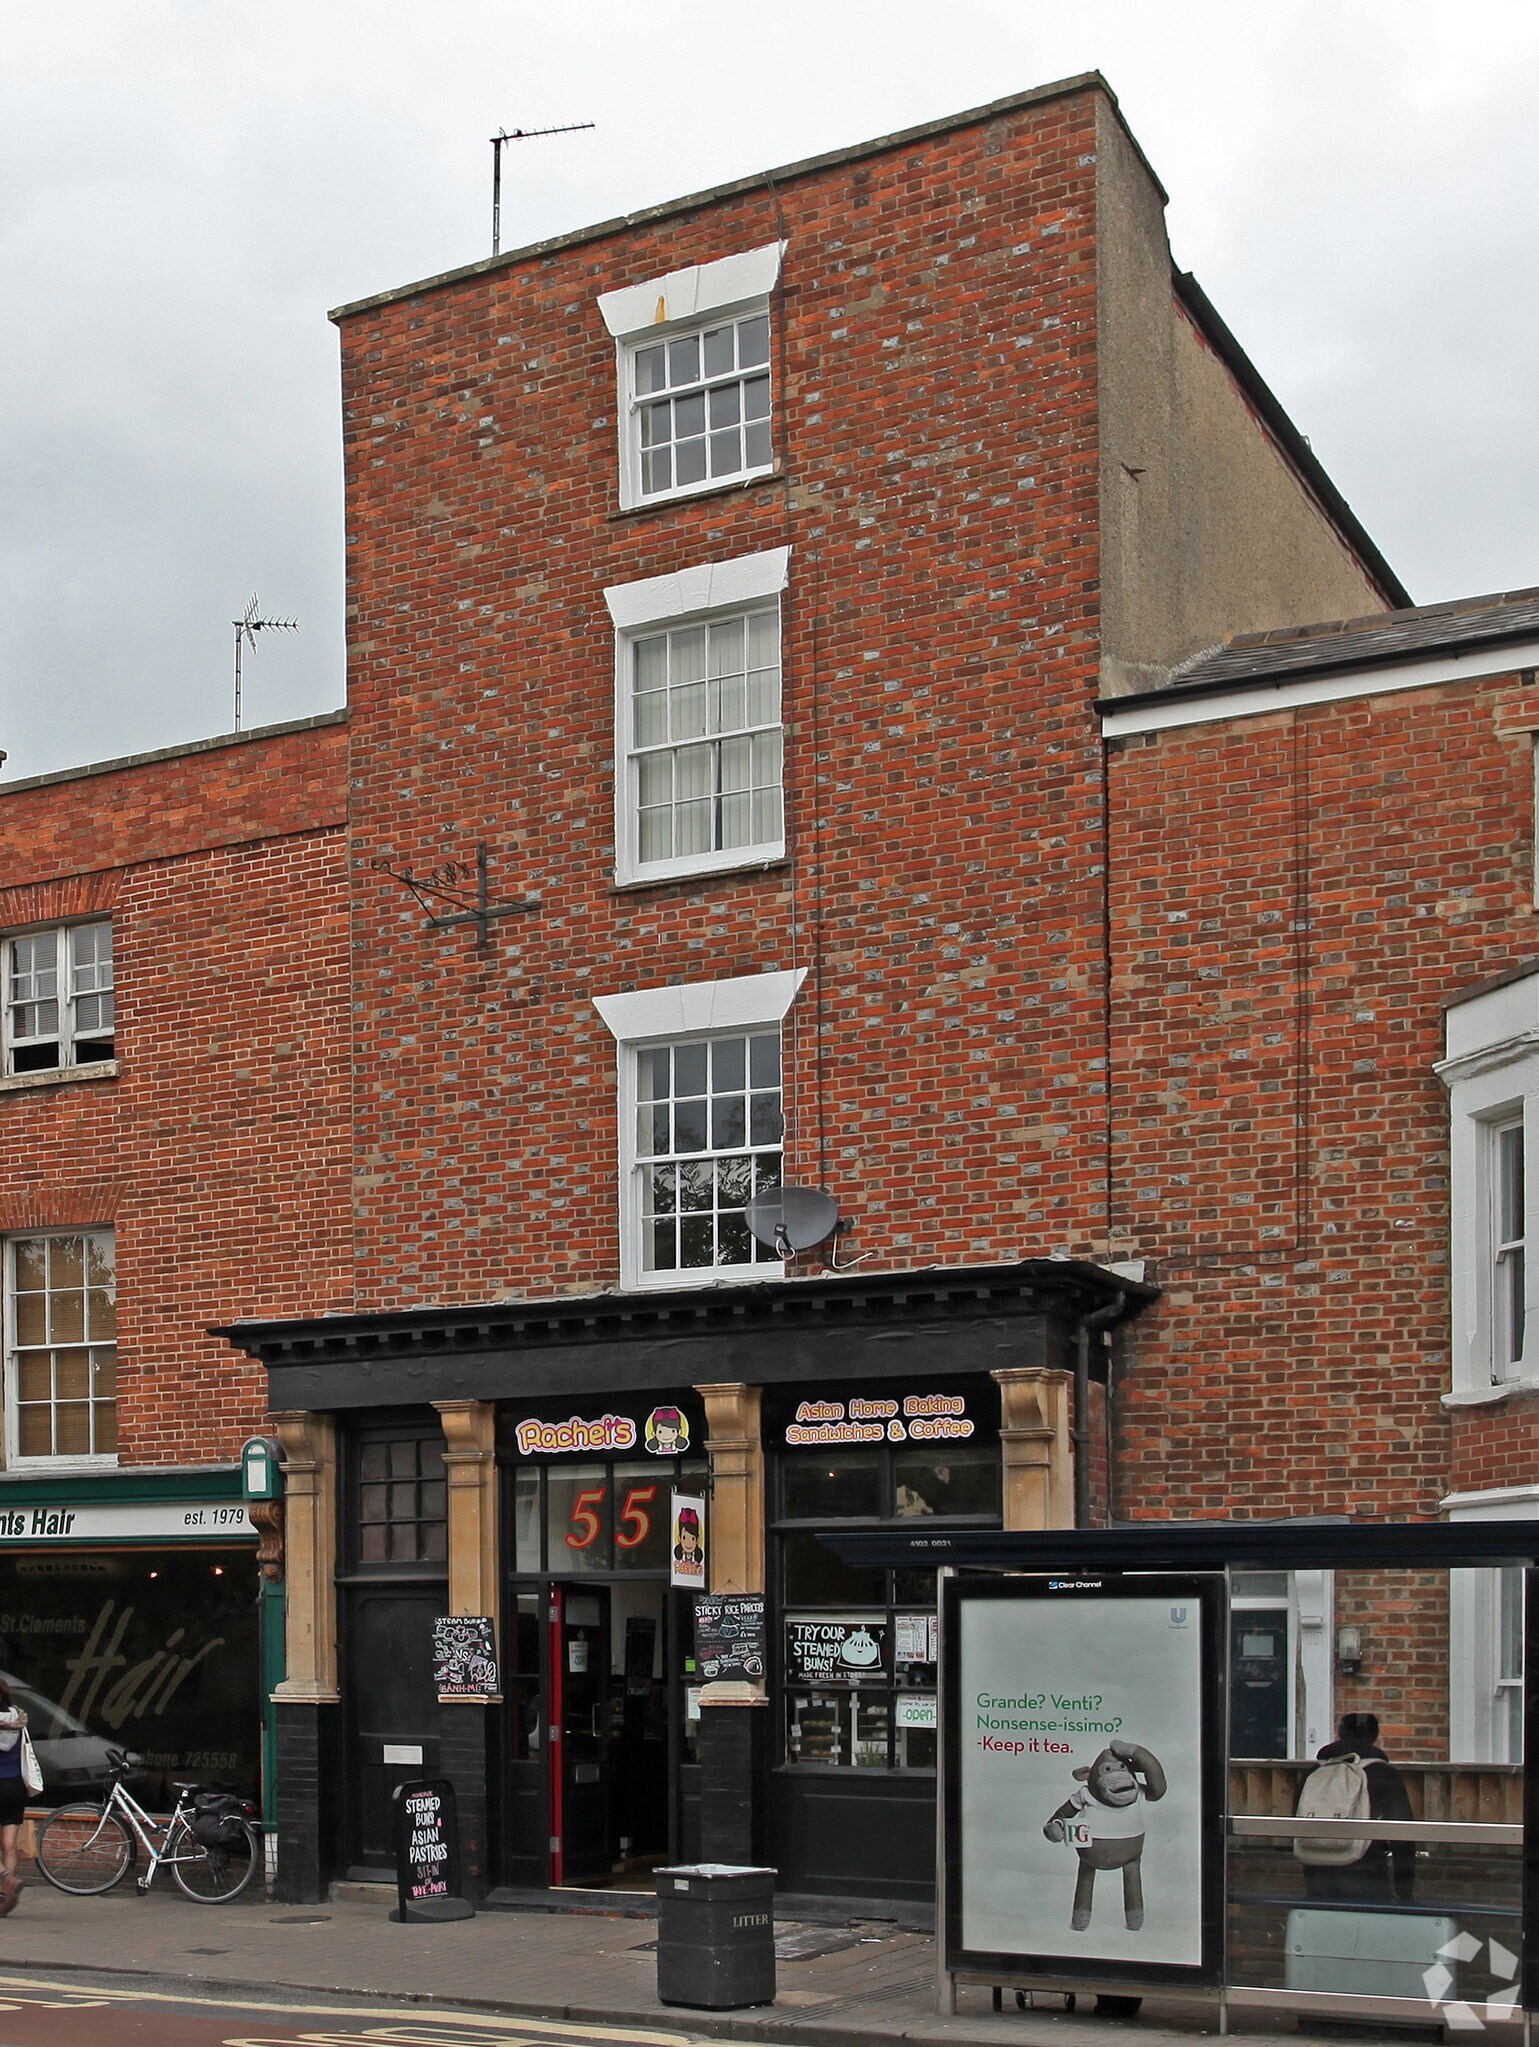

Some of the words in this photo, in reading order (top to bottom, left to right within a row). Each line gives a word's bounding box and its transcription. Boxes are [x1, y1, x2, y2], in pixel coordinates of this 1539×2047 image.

[797, 1401, 844, 1420] Asian
[849, 1398, 899, 1419] Home
[904, 1394, 965, 1416] Baking
[786, 1422, 884, 1445] Sandwiches
[887, 1419, 907, 1442] &
[909, 1417, 974, 1439] Coffee
[31, 1508, 76, 1535] Hair
[184, 1510, 207, 1525] est.
[212, 1508, 244, 1525] 1979
[1058, 1581, 1075, 1589] Clear
[1075, 1580, 1102, 1588] Channel
[695, 1604, 722, 1617] STICKY
[725, 1604, 740, 1615] RICE
[794, 1624, 821, 1641] TRY
[820, 1625, 846, 1641] OUR
[793, 1641, 841, 1657] STEAMED
[48, 1598, 226, 1740] Hair
[803, 1656, 834, 1672] BUNS!
[798, 1671, 814, 1679] MADE
[814, 1671, 834, 1679] FRESH
[976, 1692, 1046, 1710] Grande?
[1051, 1694, 1103, 1711] Venti?
[976, 1714, 1122, 1733] Nonsense-issimo?
[977, 1735, 1025, 1755] -Keep
[1029, 1737, 1040, 1753] it
[1043, 1738, 1074, 1754] tea.
[405, 1796, 441, 1814] STEAMED
[415, 1811, 435, 1827] BUNS
[411, 1826, 440, 1846] ASIAN
[409, 1843, 448, 1864] PASTRIES
[733, 1913, 769, 1928] LITTER
